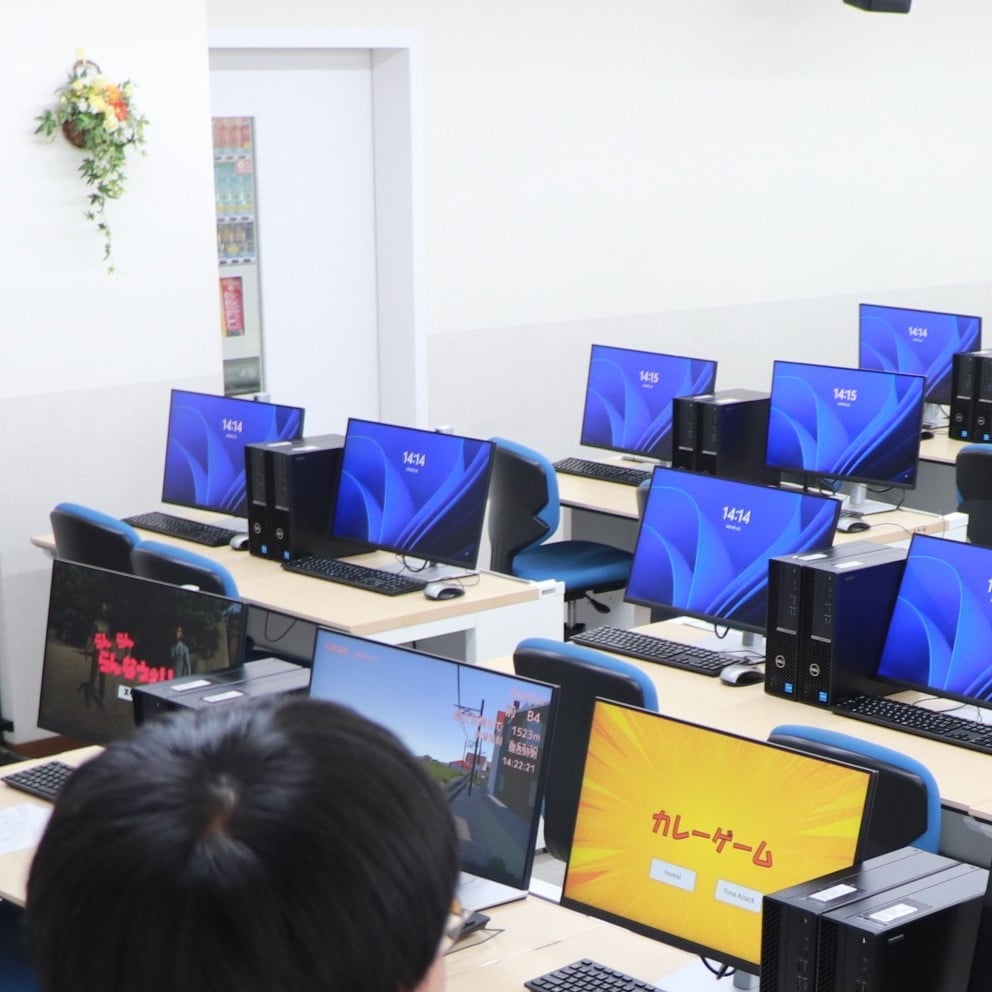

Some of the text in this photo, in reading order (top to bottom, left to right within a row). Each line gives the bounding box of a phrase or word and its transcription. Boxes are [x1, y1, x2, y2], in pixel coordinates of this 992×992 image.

[833, 388, 857, 401] 14:15
[403, 451, 426, 467] 14:14
[723, 506, 751, 524] 14:14
[526, 710, 541, 723] B4
[502, 756, 536, 774] 14:22:21
[652, 809, 774, 869] カレーゲーム
